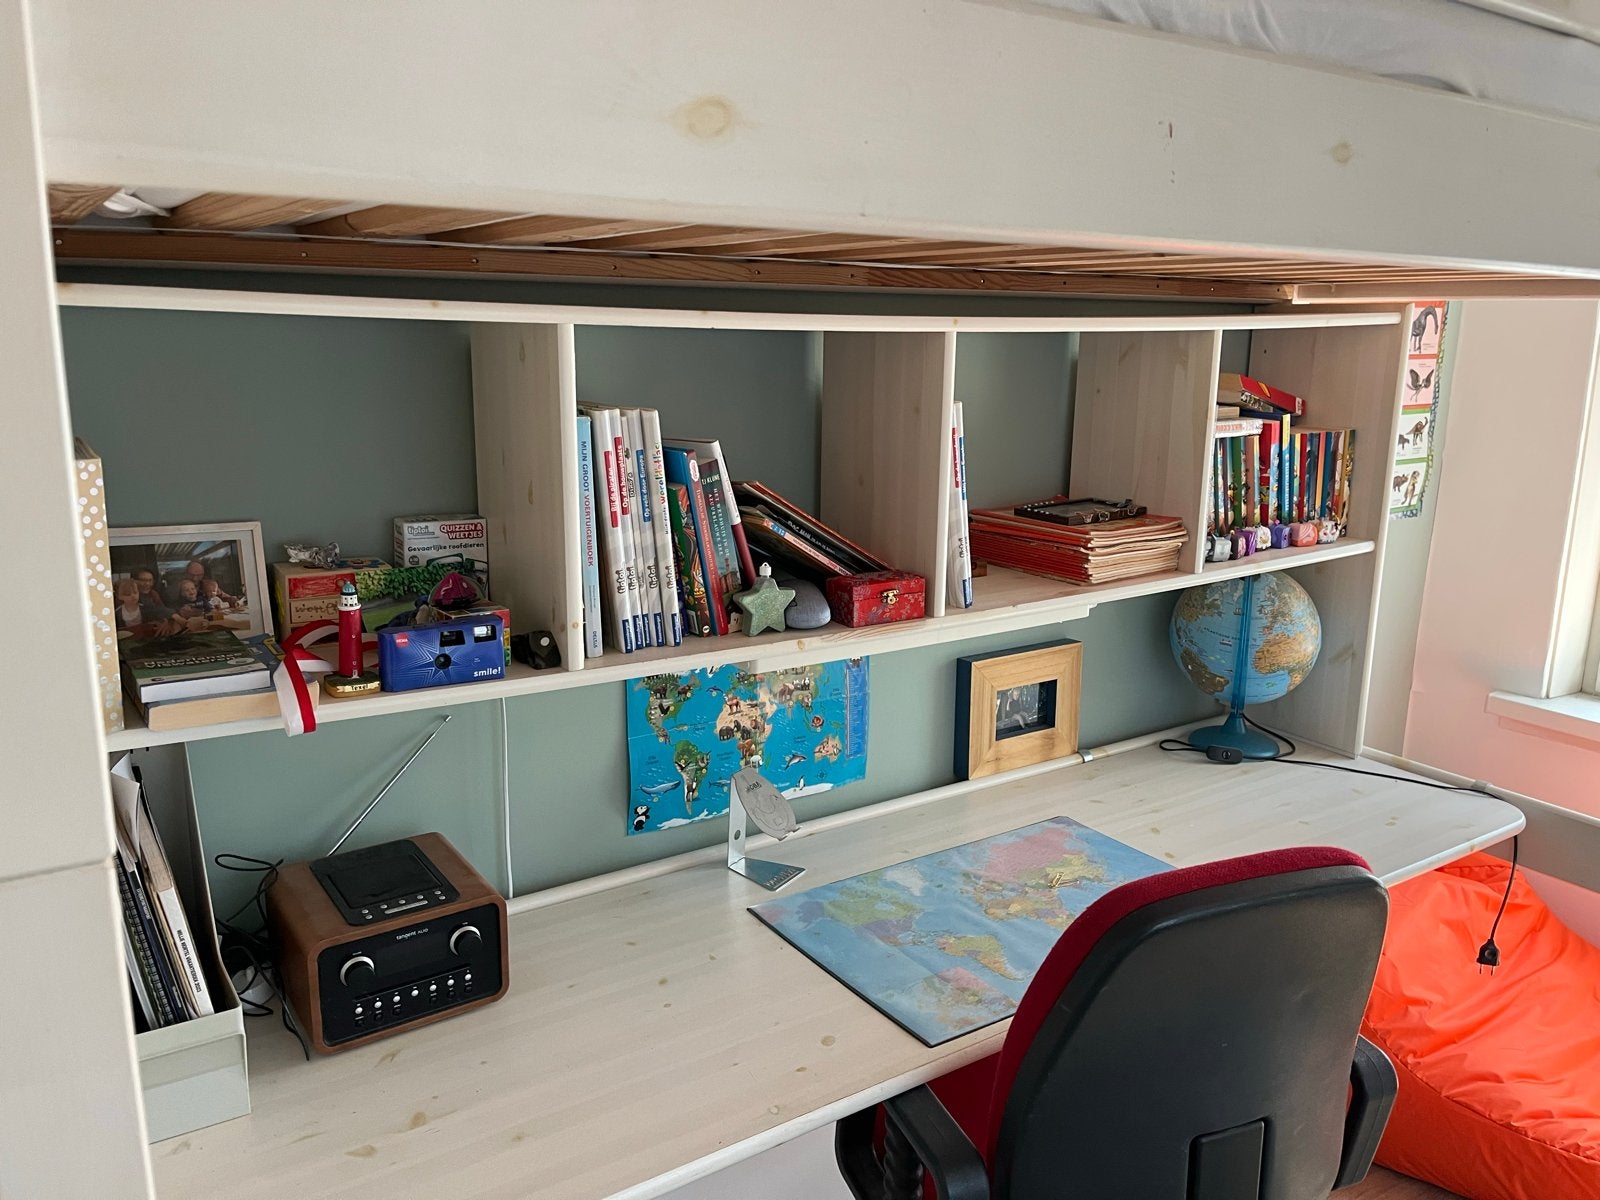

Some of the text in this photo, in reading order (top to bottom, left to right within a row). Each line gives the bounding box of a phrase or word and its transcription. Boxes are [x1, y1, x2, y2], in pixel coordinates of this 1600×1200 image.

[617, 444, 629, 507] Op de bouwplaats
[644, 508, 650, 517] Op
[716, 504, 726, 537] WEESHUIS
[407, 526, 429, 535] tiptoi
[440, 524, 474, 532] QUIZZEN
[584, 495, 594, 566] VOERTUIGENBOEK
[616, 570, 625, 594] tiptoi
[626, 566, 636, 590] tiptoi
[647, 564, 658, 589] tiptoi
[473, 667, 501, 677] smile!
[396, 931, 416, 940] tangent
